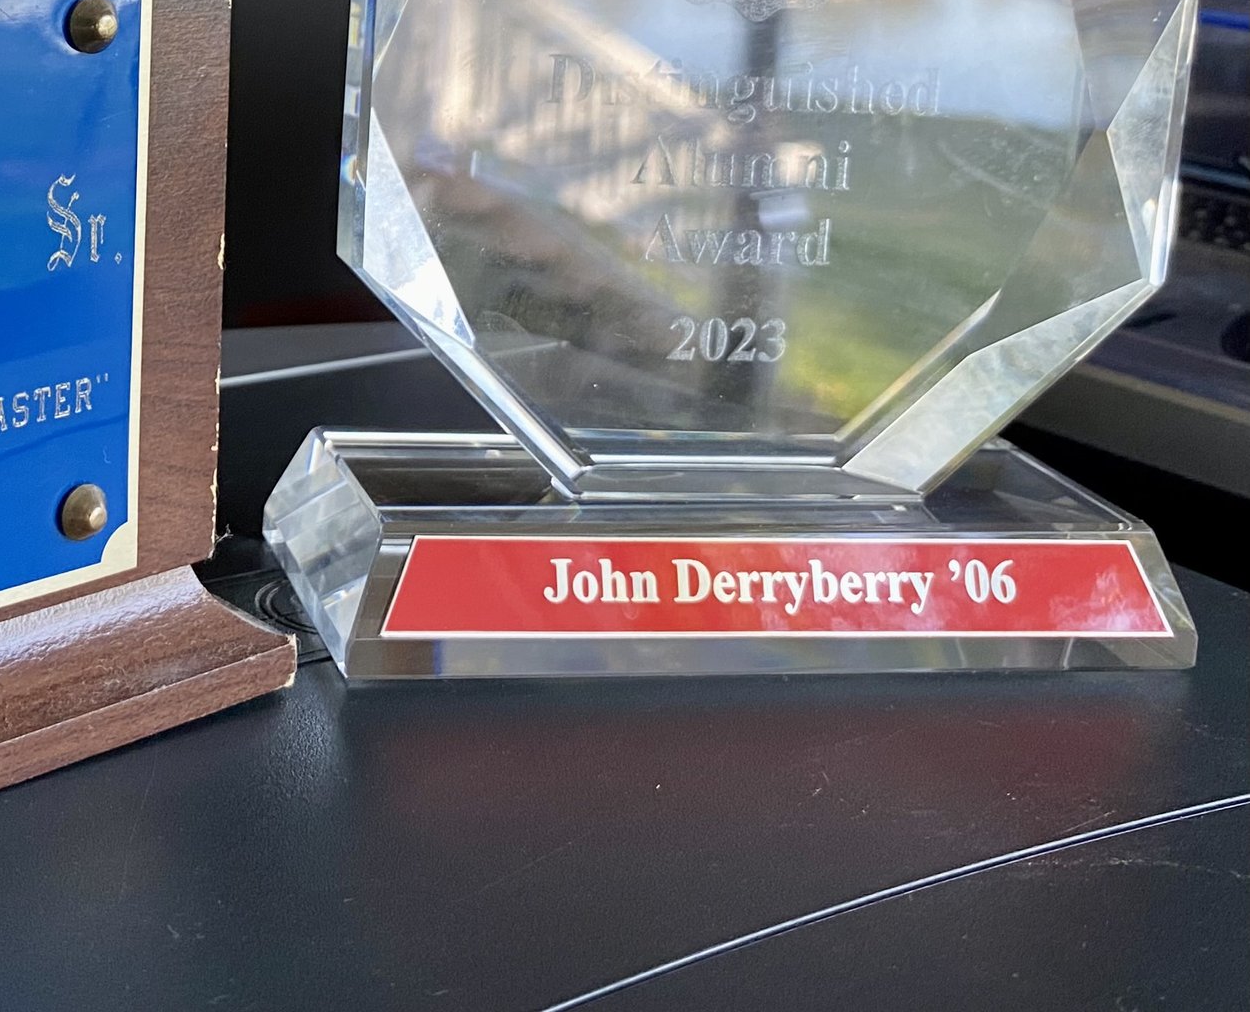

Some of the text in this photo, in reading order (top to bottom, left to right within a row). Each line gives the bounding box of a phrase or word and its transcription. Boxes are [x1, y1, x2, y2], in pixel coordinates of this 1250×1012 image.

[545, 54, 942, 124] Distinguished
[631, 134, 851, 191] Alumni
[46, 173, 123, 272] Sr.
[645, 213, 832, 267] Award
[665, 316, 788, 363] 2023
[543, 557, 662, 604] John
[671, 557, 936, 616] Derryberry
